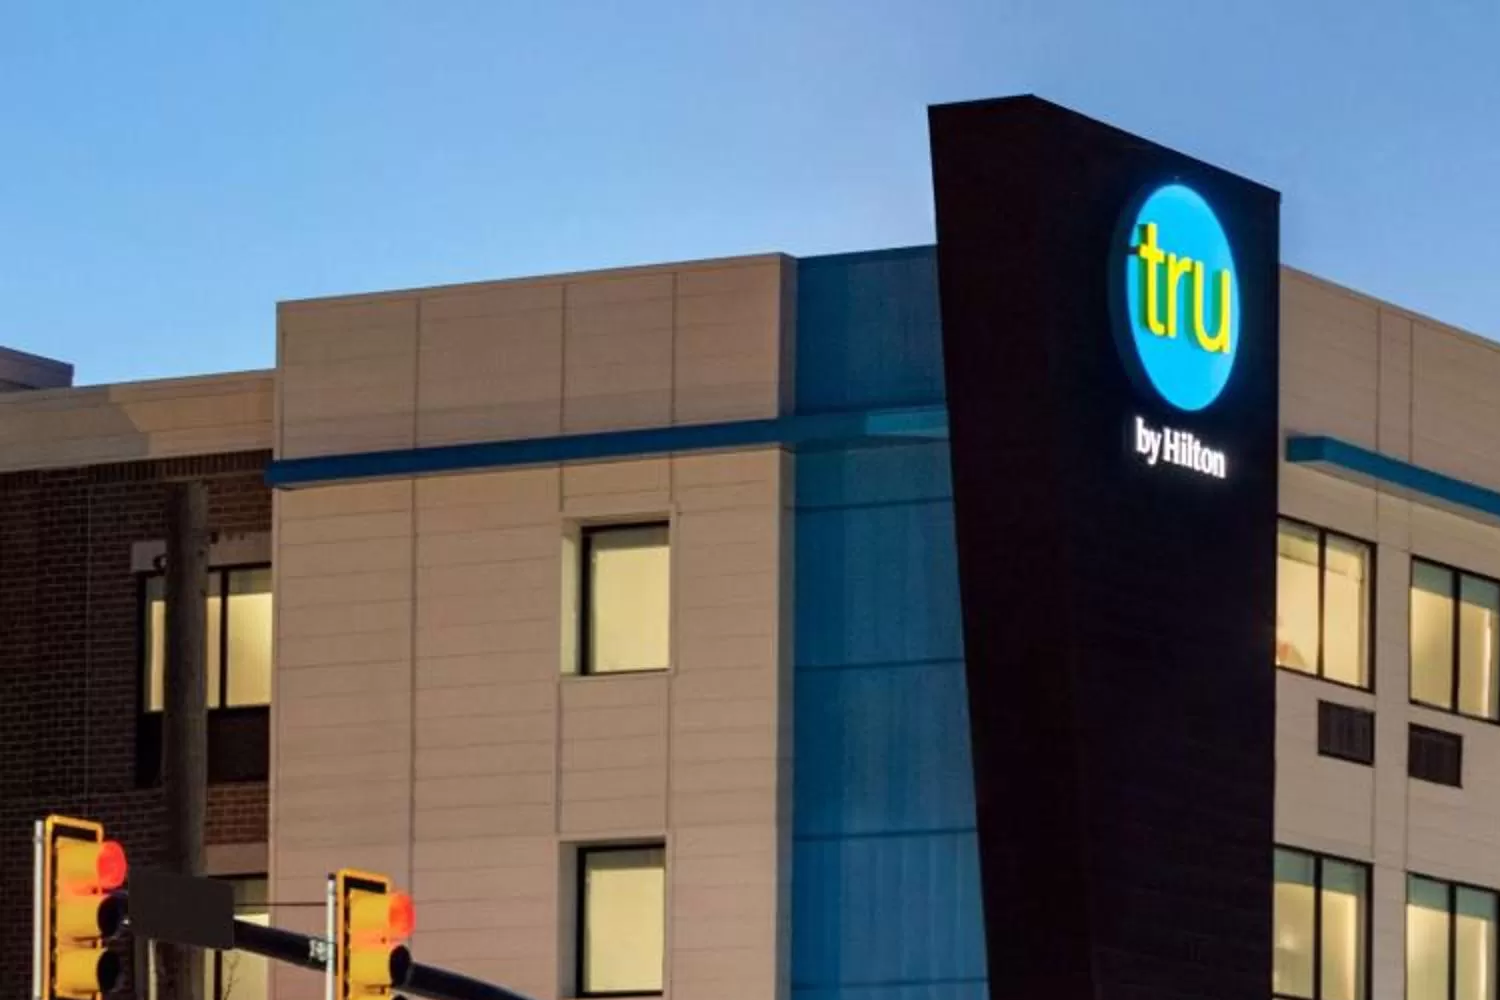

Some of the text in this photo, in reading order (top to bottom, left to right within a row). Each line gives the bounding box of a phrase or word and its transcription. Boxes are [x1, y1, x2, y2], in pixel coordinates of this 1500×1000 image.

[1138, 222, 1232, 354] tru
[1134, 416, 1226, 478] by Hilton
